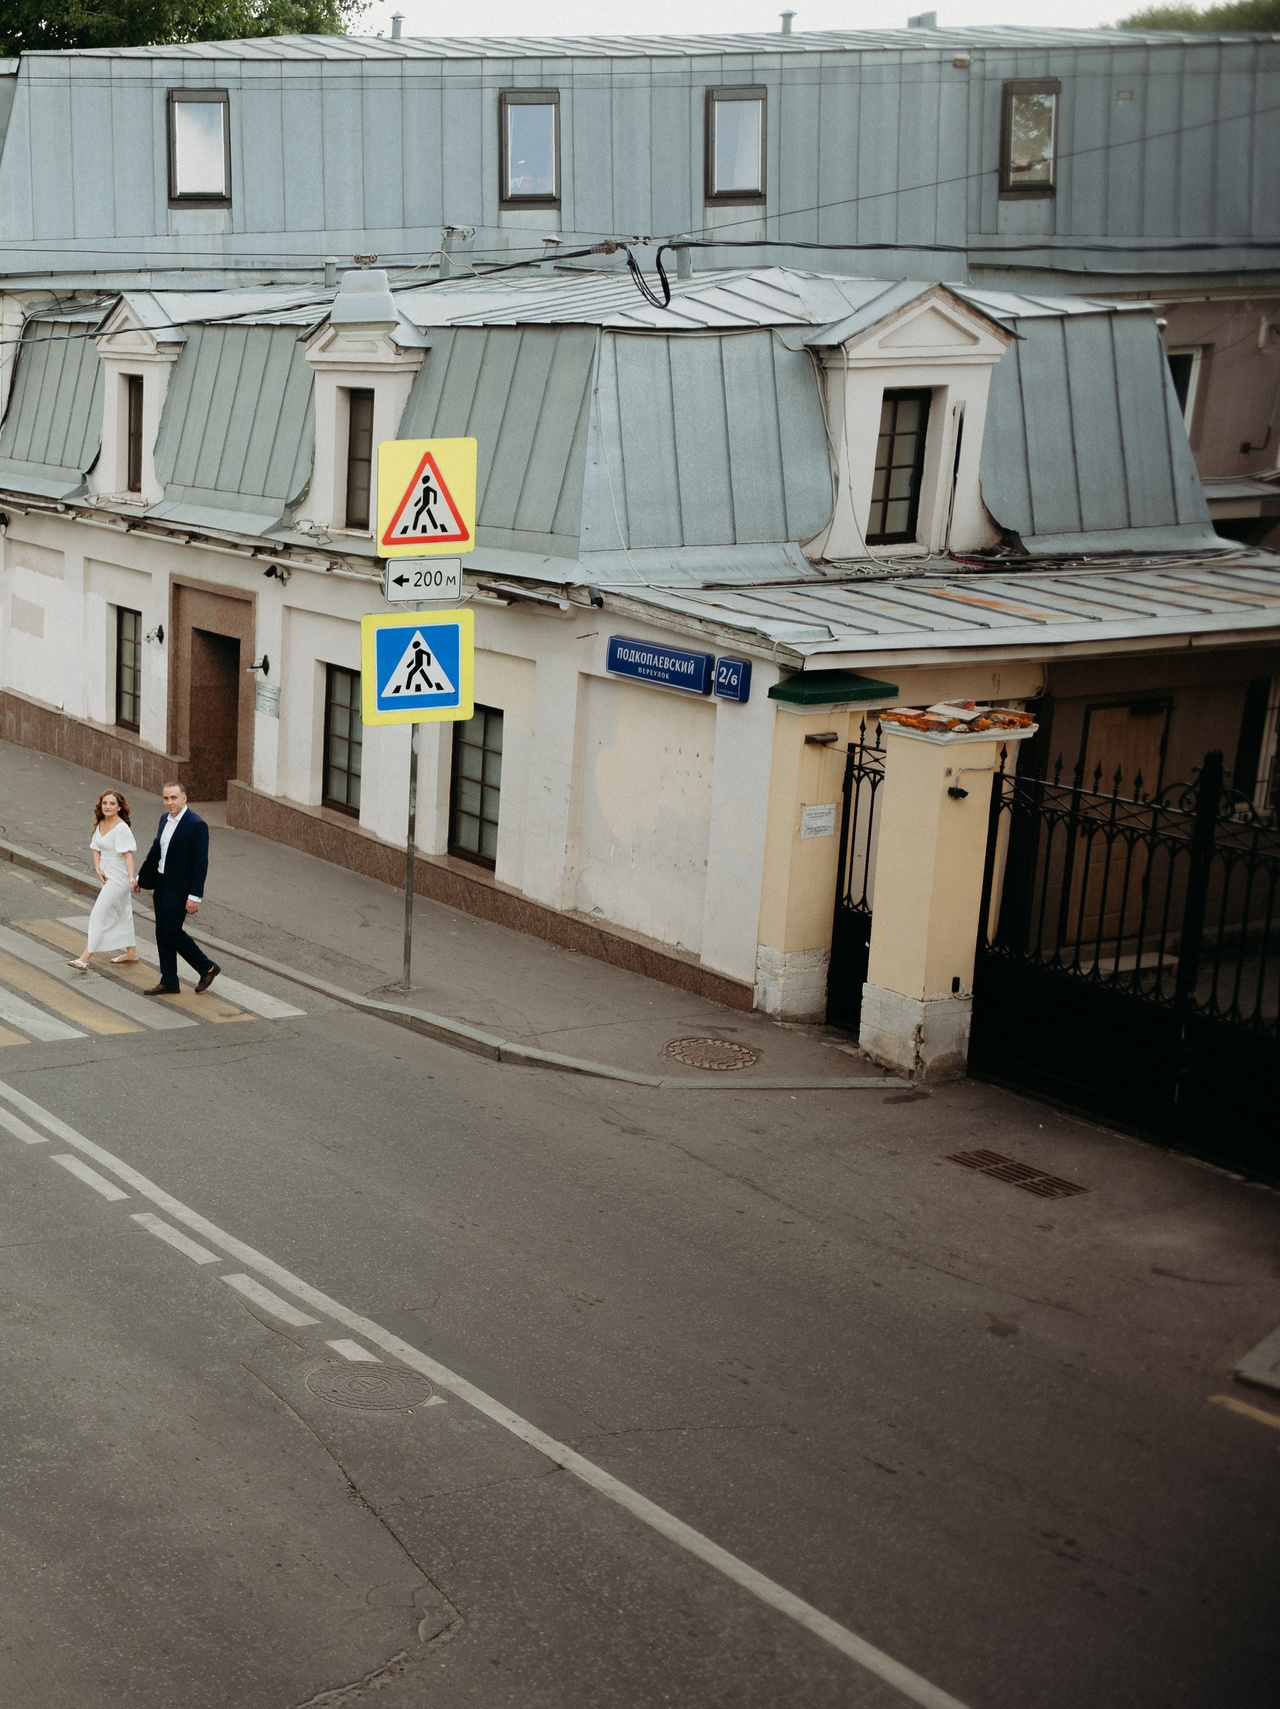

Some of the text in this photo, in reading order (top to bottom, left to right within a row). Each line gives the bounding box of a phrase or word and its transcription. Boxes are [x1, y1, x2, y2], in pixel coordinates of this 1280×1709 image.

[413, 570, 443, 588] 200
[616, 646, 695, 675] ПОДКОПАЕВСКИЙ
[637, 666, 670, 680] ПЕРЕУЛОК
[718, 666, 738, 686] 2/6
